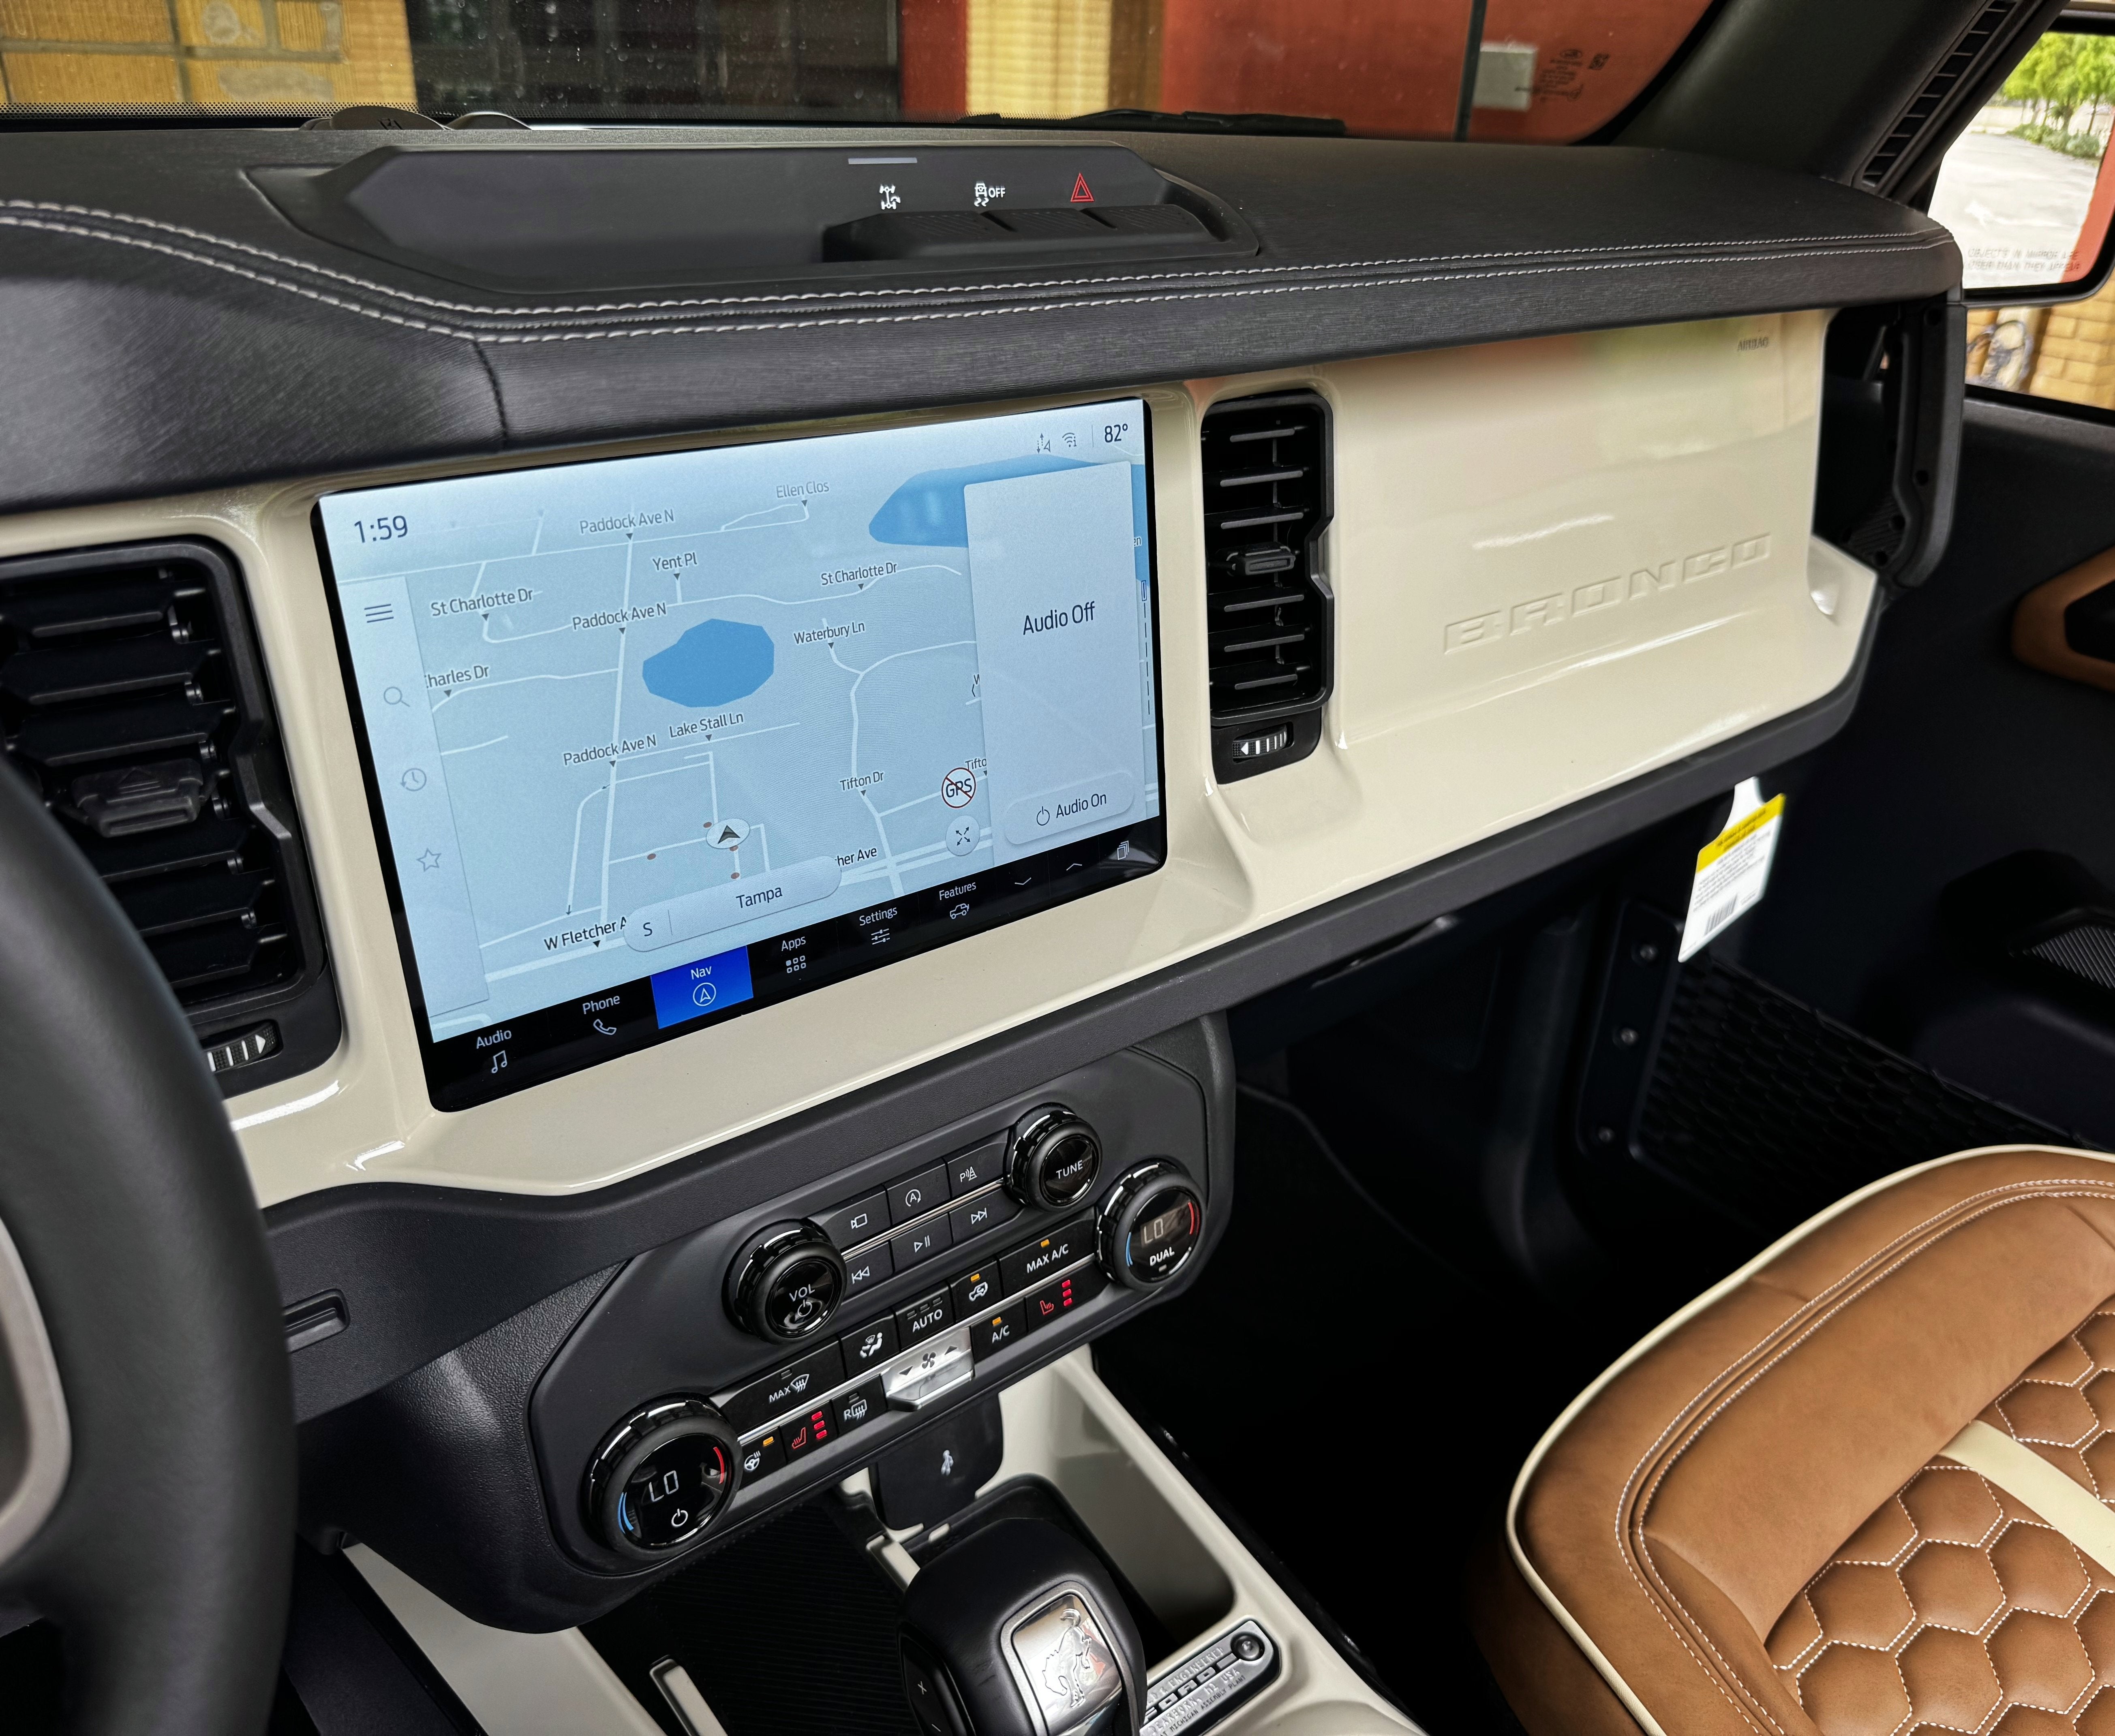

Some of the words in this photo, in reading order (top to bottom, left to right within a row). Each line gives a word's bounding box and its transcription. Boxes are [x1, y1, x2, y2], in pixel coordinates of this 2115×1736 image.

[988, 187, 1006, 198] OFF
[776, 484, 804, 498] Ellen
[806, 481, 829, 494] Clos
[355, 515, 408, 543] 1:59
[580, 514, 636, 534] Paddock
[639, 512, 662, 527] Ave
[665, 509, 674, 522] N
[653, 556, 682, 571] Yent
[685, 552, 698, 567] Pl
[821, 572, 833, 585] St
[835, 565, 884, 582] Charlotte
[886, 562, 897, 574] Dr
[431, 601, 448, 616] St
[450, 591, 516, 613] Charlotte
[517, 588, 533, 603] Dr
[1444, 533, 1771, 655] BRONCO
[573, 609, 629, 630] Paddock
[632, 607, 655, 621] Ave
[657, 603, 667, 615] N
[1023, 609, 1069, 635] Audio
[1072, 601, 1095, 620] Off
[794, 624, 850, 645] Waterbury
[852, 621, 865, 633] Ln
[424, 670, 472, 688] harles
[473, 665, 489, 679] Dr
[670, 722, 698, 738] Lake
[700, 716, 727, 731] Stall
[729, 713, 744, 725] Ln
[564, 744, 619, 765] Paddock
[622, 740, 645, 753] Ave
[647, 735, 657, 747] N
[840, 774, 871, 791] Tifton
[873, 771, 884, 782] Dr
[946, 778, 972, 797] GPS
[1055, 796, 1088, 818] Audio
[1090, 792, 1107, 807] On
[835, 854, 854, 866] her
[857, 848, 877, 861] Ave
[736, 885, 782, 909] Tampa
[939, 881, 977, 900] Features
[859, 905, 898, 927] Settings
[544, 936, 558, 950] W
[562, 922, 616, 946] Fletcher
[643, 922, 653, 936] S
[781, 935, 807, 953] Apps
[691, 966, 712, 980] Nav
[582, 994, 621, 1015] Phone
[475, 1028, 512, 1050] Audio
[1056, 1160, 1083, 1179] TUNE
[1144, 1218, 1163, 1243] LO
[1027, 1254, 1049, 1273] MAX
[1052, 1244, 1069, 1261] A/C
[1150, 1247, 1175, 1266] DUAL
[789, 1283, 815, 1302] VOL
[912, 1309, 943, 1332] AUTO
[992, 1325, 1010, 1343] A/C
[769, 1387, 790, 1402] MAX
[649, 1470, 679, 1502] LO
[1168, 1647, 1224, 1687] ENGINEERED
[1220, 1668, 1240, 1684] USA
[1143, 1667, 1216, 1724] FORD
[1169, 1711, 1199, 1732] MICHIGAN
[1201, 1689, 1227, 1709] ASSEMBLY
[1228, 1675, 1246, 1689] PLANT
